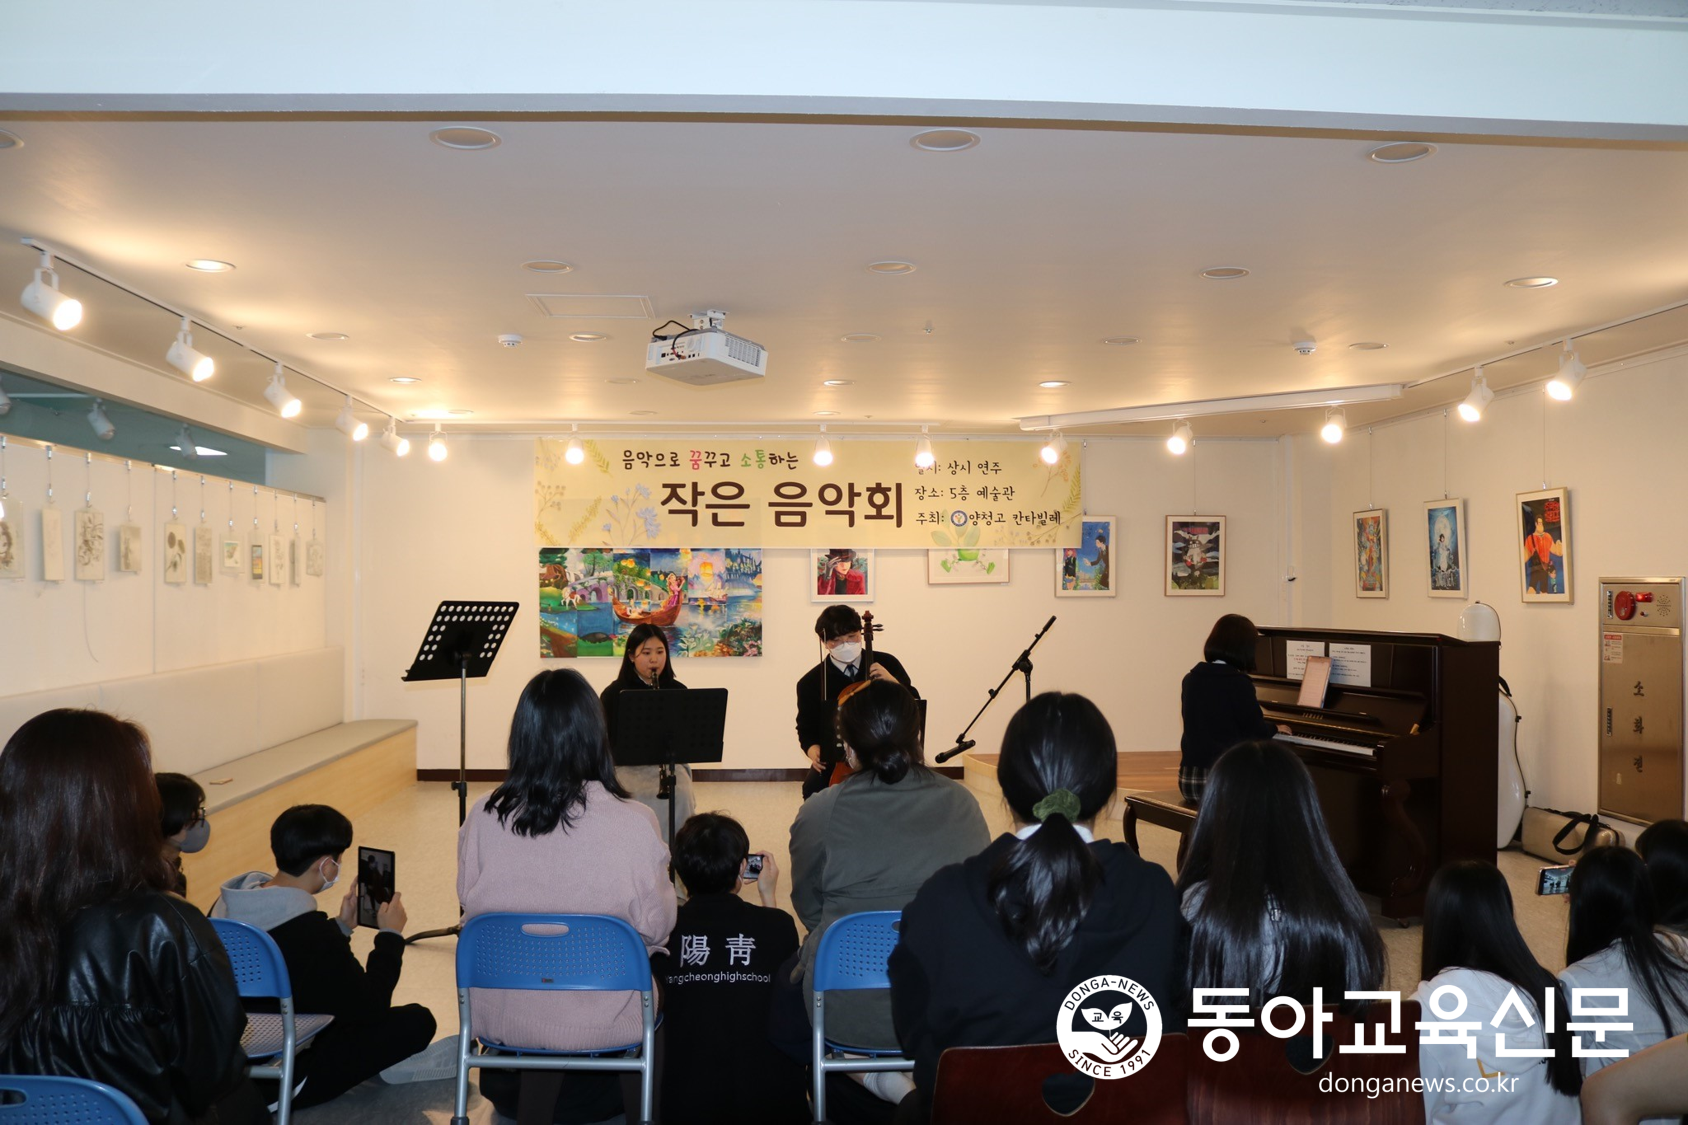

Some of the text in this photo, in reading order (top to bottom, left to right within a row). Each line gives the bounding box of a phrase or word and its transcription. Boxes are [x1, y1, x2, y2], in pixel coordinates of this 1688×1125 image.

[622, 450, 798, 470] 음악으로 꿈꾸고 소통하는
[947, 460, 971, 475] 상시
[977, 461, 1002, 475] 연주
[914, 484, 1015, 502] 장소: 5층 예술관
[660, 481, 902, 528] 작은 음악회
[915, 510, 1061, 526] 주최: 양청고 칸타빌레
